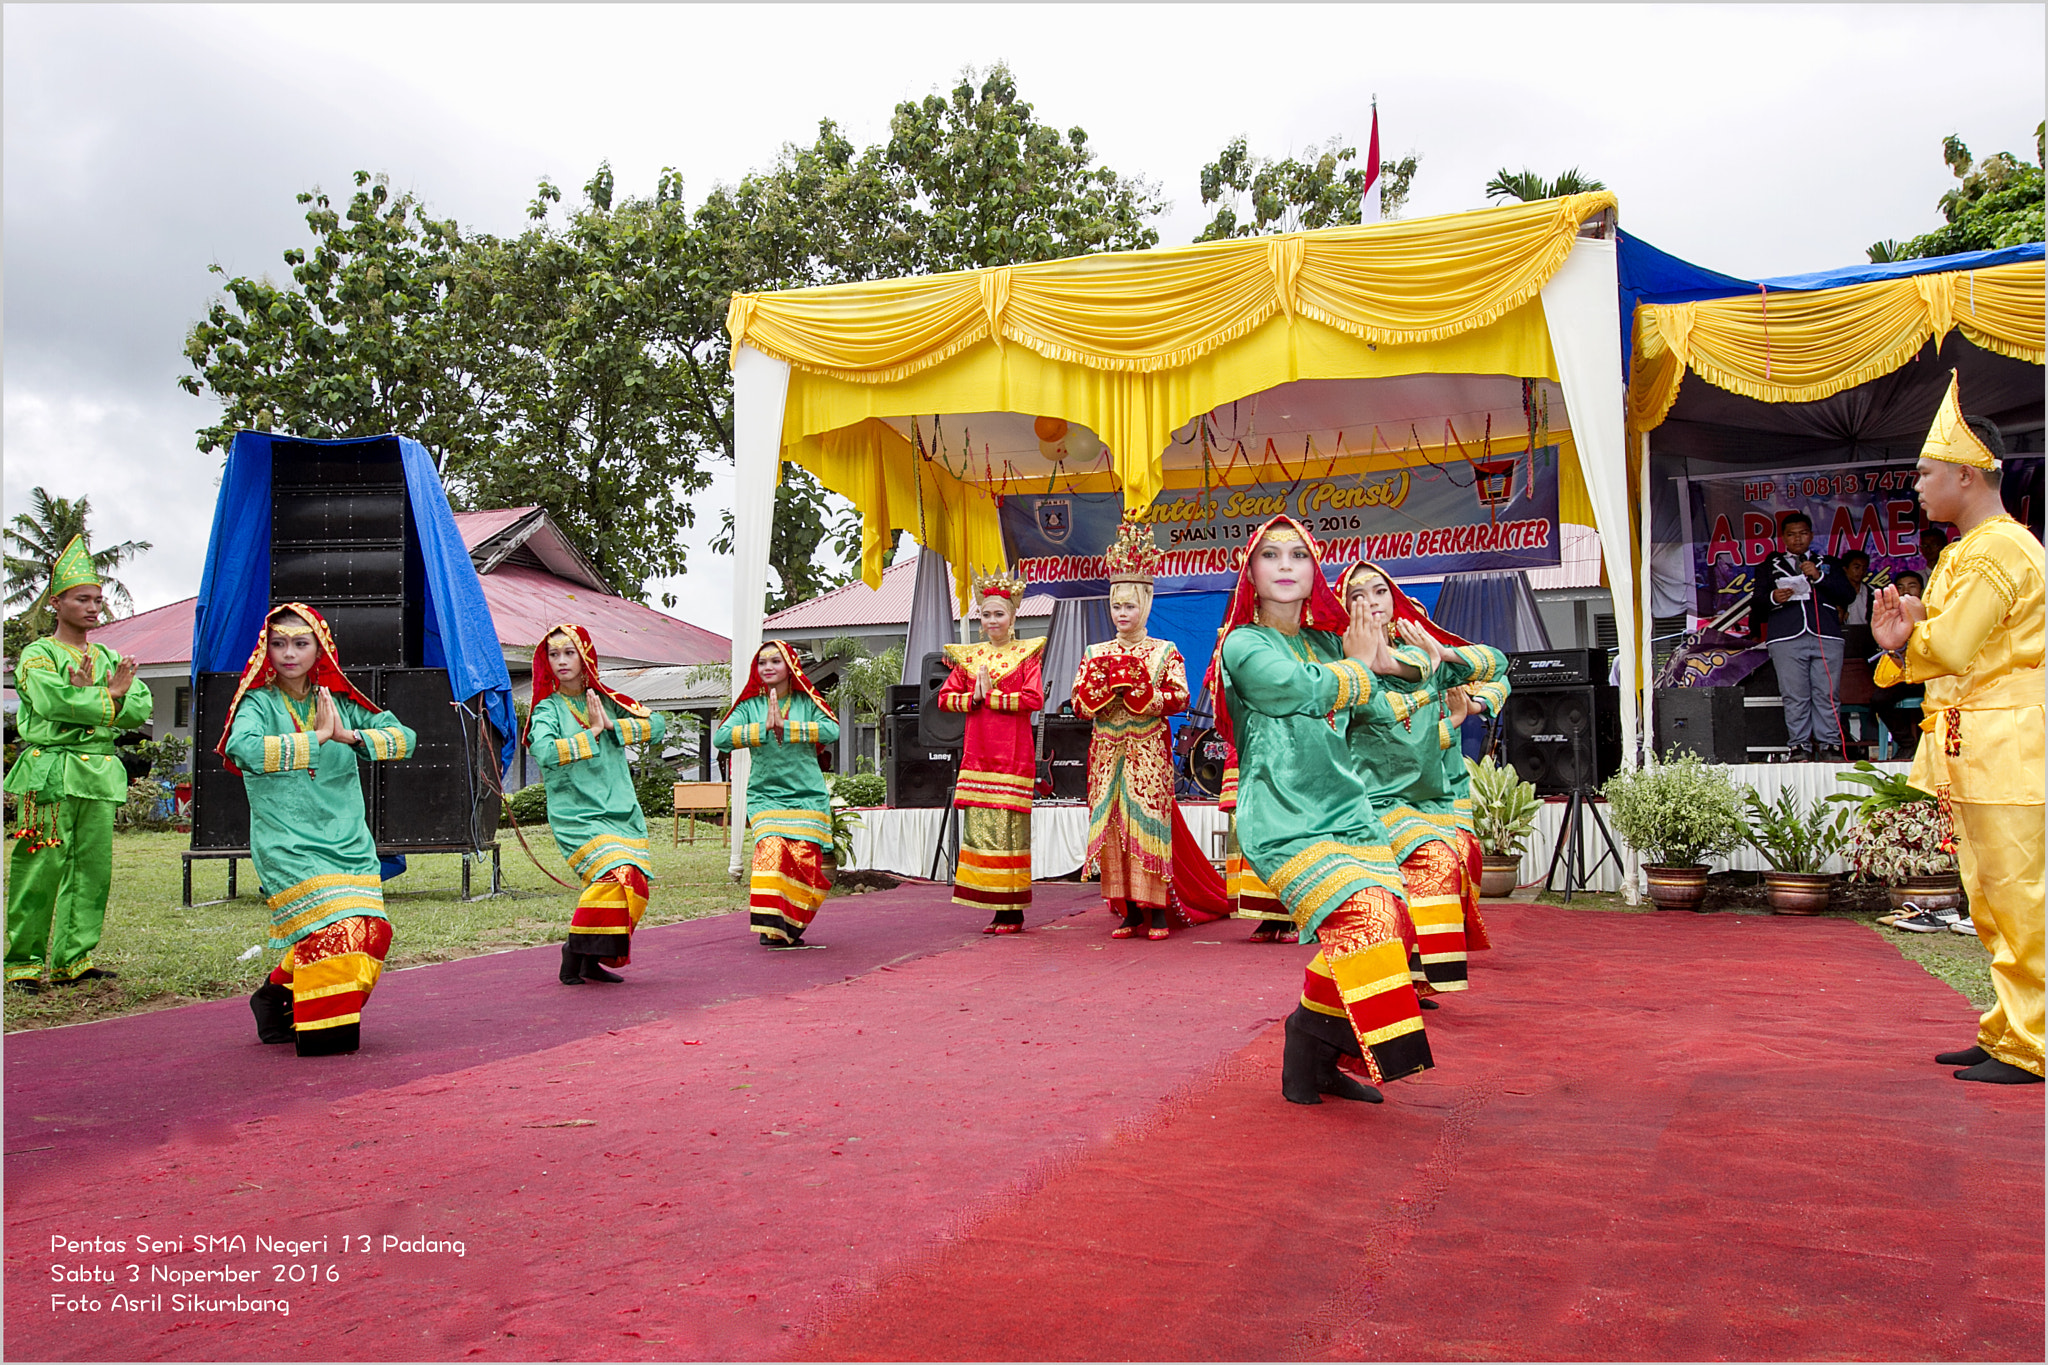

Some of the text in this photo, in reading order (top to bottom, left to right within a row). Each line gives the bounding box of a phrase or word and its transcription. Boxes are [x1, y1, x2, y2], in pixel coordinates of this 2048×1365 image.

[1138, 470, 1412, 524] entas Seni (Pensi)
[1743, 481, 1776, 501] HP
[1801, 475, 1859, 497] 0813
[1170, 526, 1217, 543] SMAN
[1222, 524, 1242, 539] 13
[1318, 515, 1361, 532] 2016
[1151, 546, 1229, 579] ATIVITAS
[1364, 531, 1414, 562] YANG
[1414, 517, 1550, 559] BERKARAKTER
[928, 752, 952, 762] Laney
